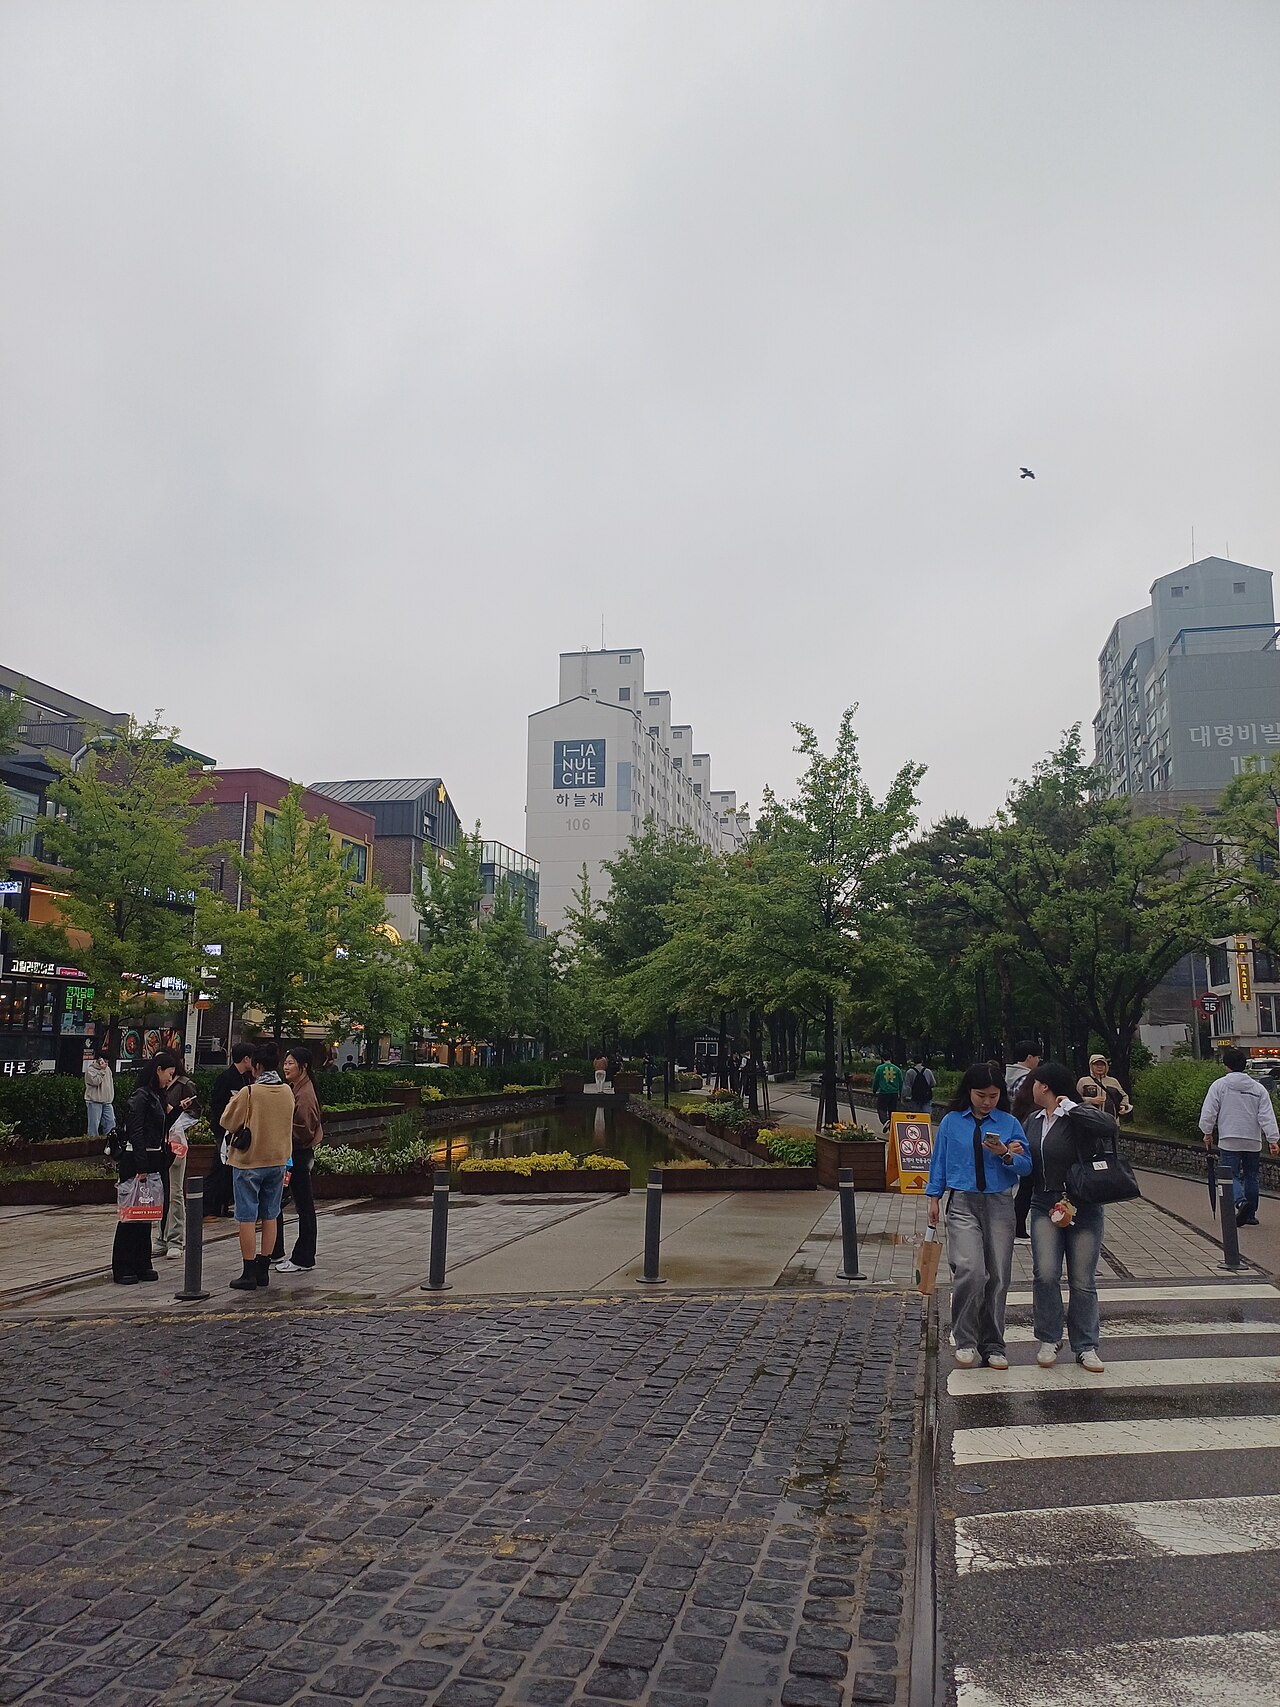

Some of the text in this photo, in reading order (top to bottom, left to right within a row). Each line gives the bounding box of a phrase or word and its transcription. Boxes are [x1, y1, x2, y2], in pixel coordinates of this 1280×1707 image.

[1188, 722, 1280, 747] 대명비발
[562, 757, 596, 771] NUL
[562, 772, 596, 785] CHE
[556, 792, 604, 808] 하늘채
[565, 818, 590, 831] 106
[3, 1062, 27, 1077] 타로
